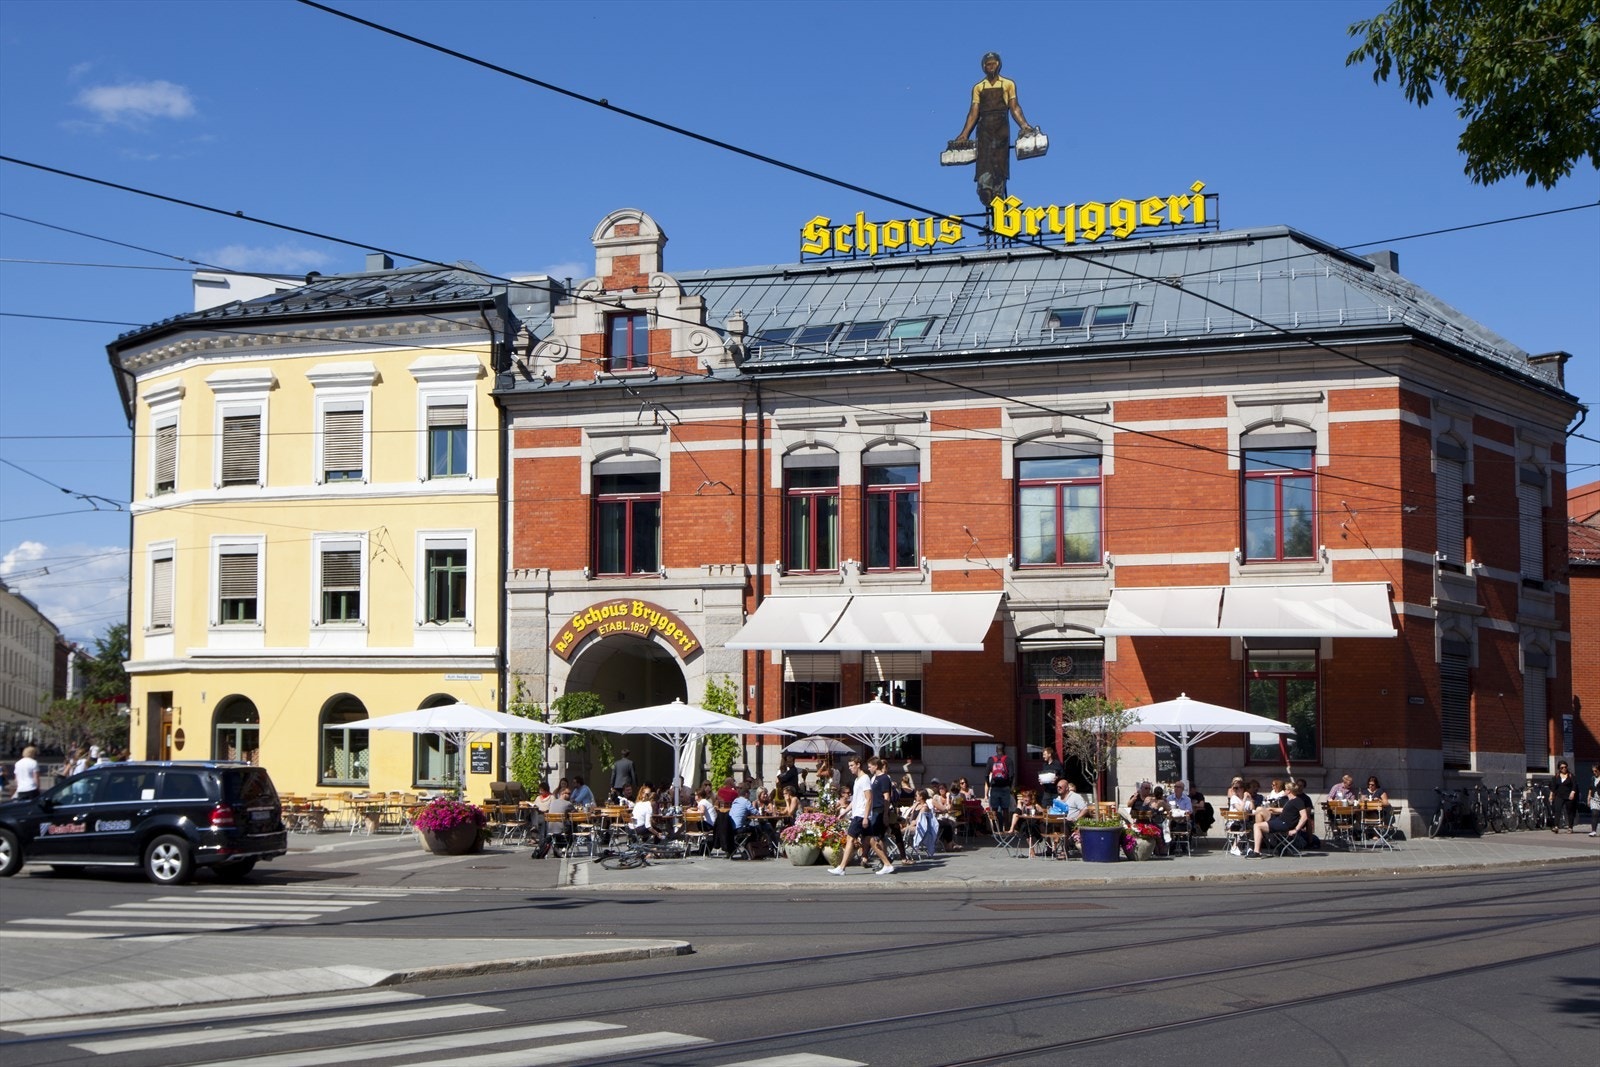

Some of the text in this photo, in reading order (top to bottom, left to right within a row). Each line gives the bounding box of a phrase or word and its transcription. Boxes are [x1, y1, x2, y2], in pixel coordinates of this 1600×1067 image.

[801, 180, 1206, 256] Schous Bryggeri
[572, 604, 628, 632] Schous
[631, 601, 696, 651] Bryggeri
